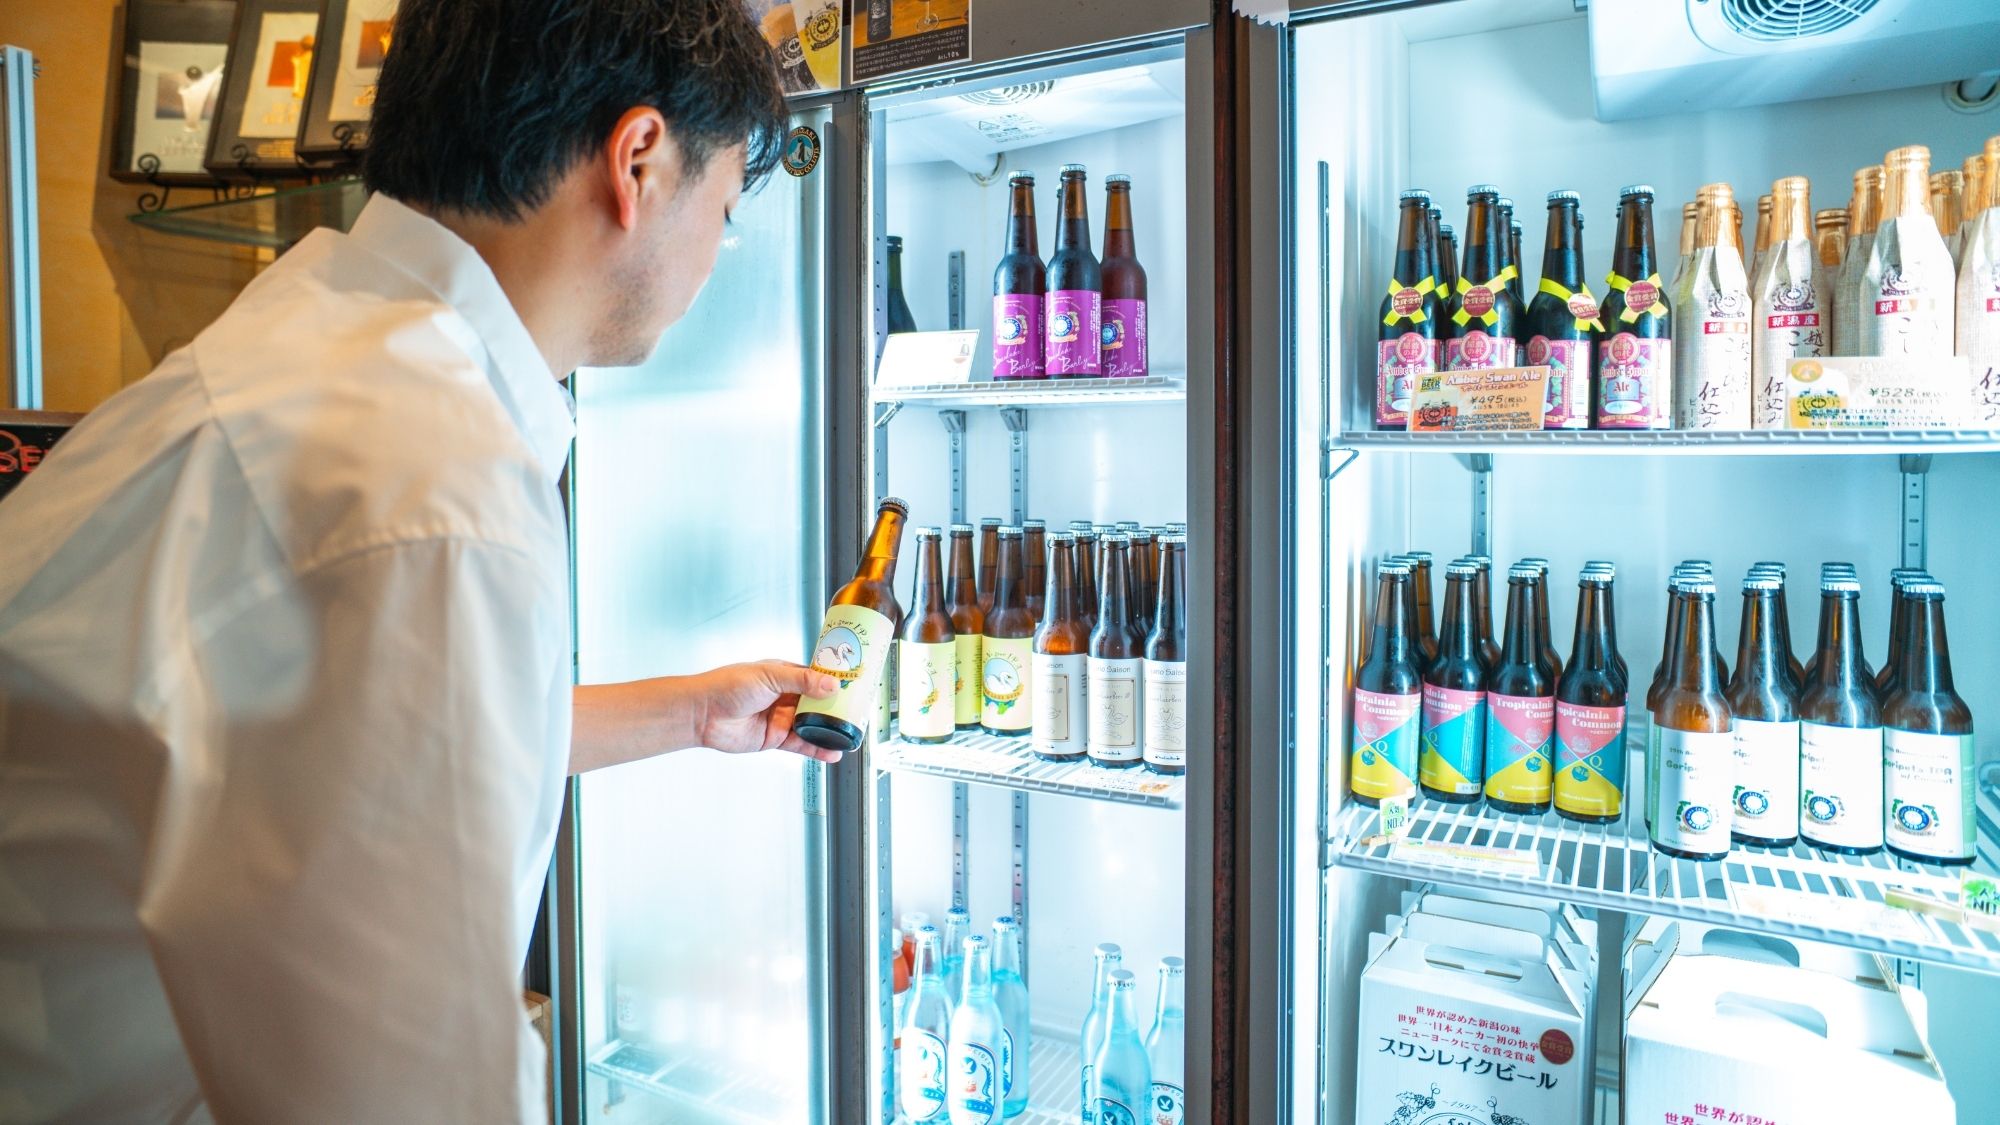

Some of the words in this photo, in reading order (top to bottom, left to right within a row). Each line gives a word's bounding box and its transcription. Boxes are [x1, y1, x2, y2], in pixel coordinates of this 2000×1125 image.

[1771, 315, 1817, 328] 新潟産
[1401, 379, 1413, 390] Al
[1421, 381, 1441, 389] BEER
[1445, 374, 1482, 386] Amber
[1485, 372, 1517, 383] Swan
[1520, 370, 1542, 381] Ale
[1613, 382, 1630, 392] Ale
[1106, 665, 1131, 673] Saison
[1571, 717, 1622, 730] Common
[1428, 731, 1439, 747] Q
[1375, 740, 1390, 756] Q
[1541, 743, 1550, 758] Q
[1589, 755, 1604, 771] Q
[1386, 815, 1405, 830] NO.2
[1416, 1005, 1521, 1036] 世界が認めた新潟の味
[1400, 1027, 1537, 1065] ニューヨークにて金賞受賞蔵
[1378, 1036, 1558, 1090] スワンレイクビール
